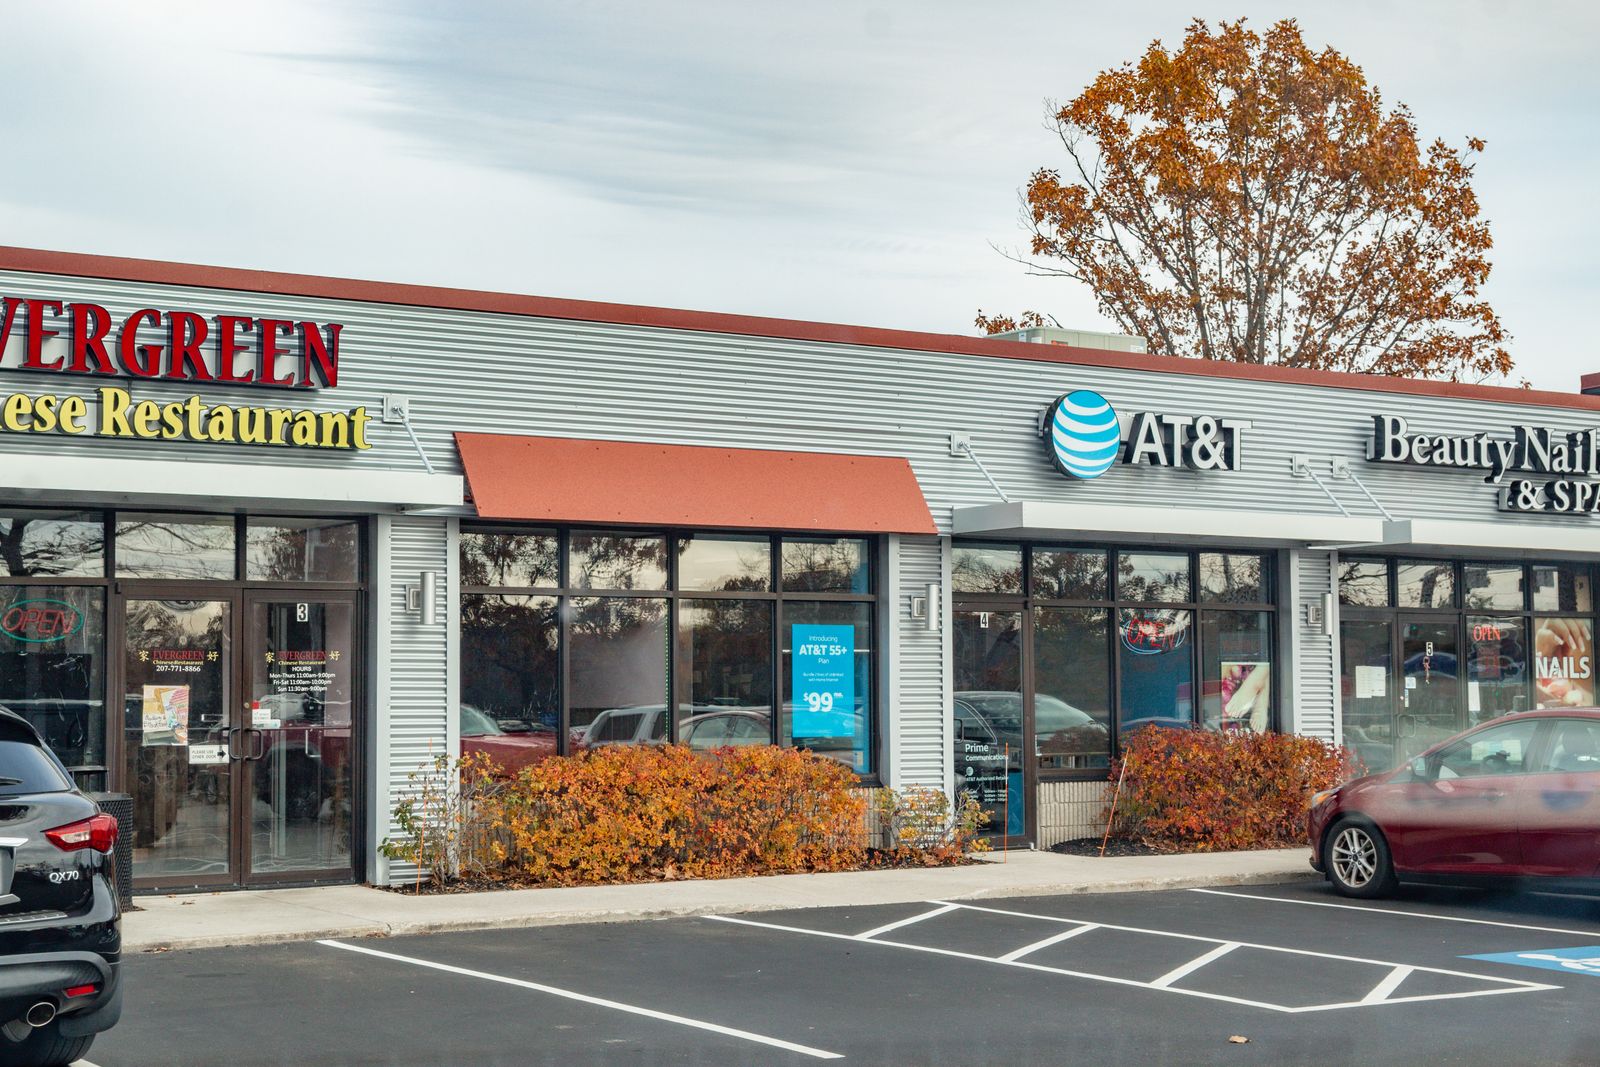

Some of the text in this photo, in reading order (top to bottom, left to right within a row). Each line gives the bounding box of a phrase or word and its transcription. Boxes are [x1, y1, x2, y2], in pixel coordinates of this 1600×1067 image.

[0, 386, 374, 450] ese Restaurant
[1126, 411, 1252, 472] AT&T
[1376, 414, 1518, 484] Beauty
[1512, 479, 1546, 510] &
[3, 607, 77, 634] OPEN
[298, 604, 308, 621] 3
[981, 613, 988, 628] 4
[808, 635, 838, 643] Introducing
[1127, 617, 1176, 649] OPEN
[1473, 624, 1501, 642] OPEN
[152, 650, 205, 660] EVERGREEN
[277, 650, 326, 660] EVERGREEN
[799, 644, 848, 656] AT&T 55+
[1426, 642, 1433, 656] 5
[1535, 656, 1591, 680] NAILS
[803, 691, 833, 713] $99
[965, 743, 989, 753] Prime
[49, 870, 80, 884] QX70
